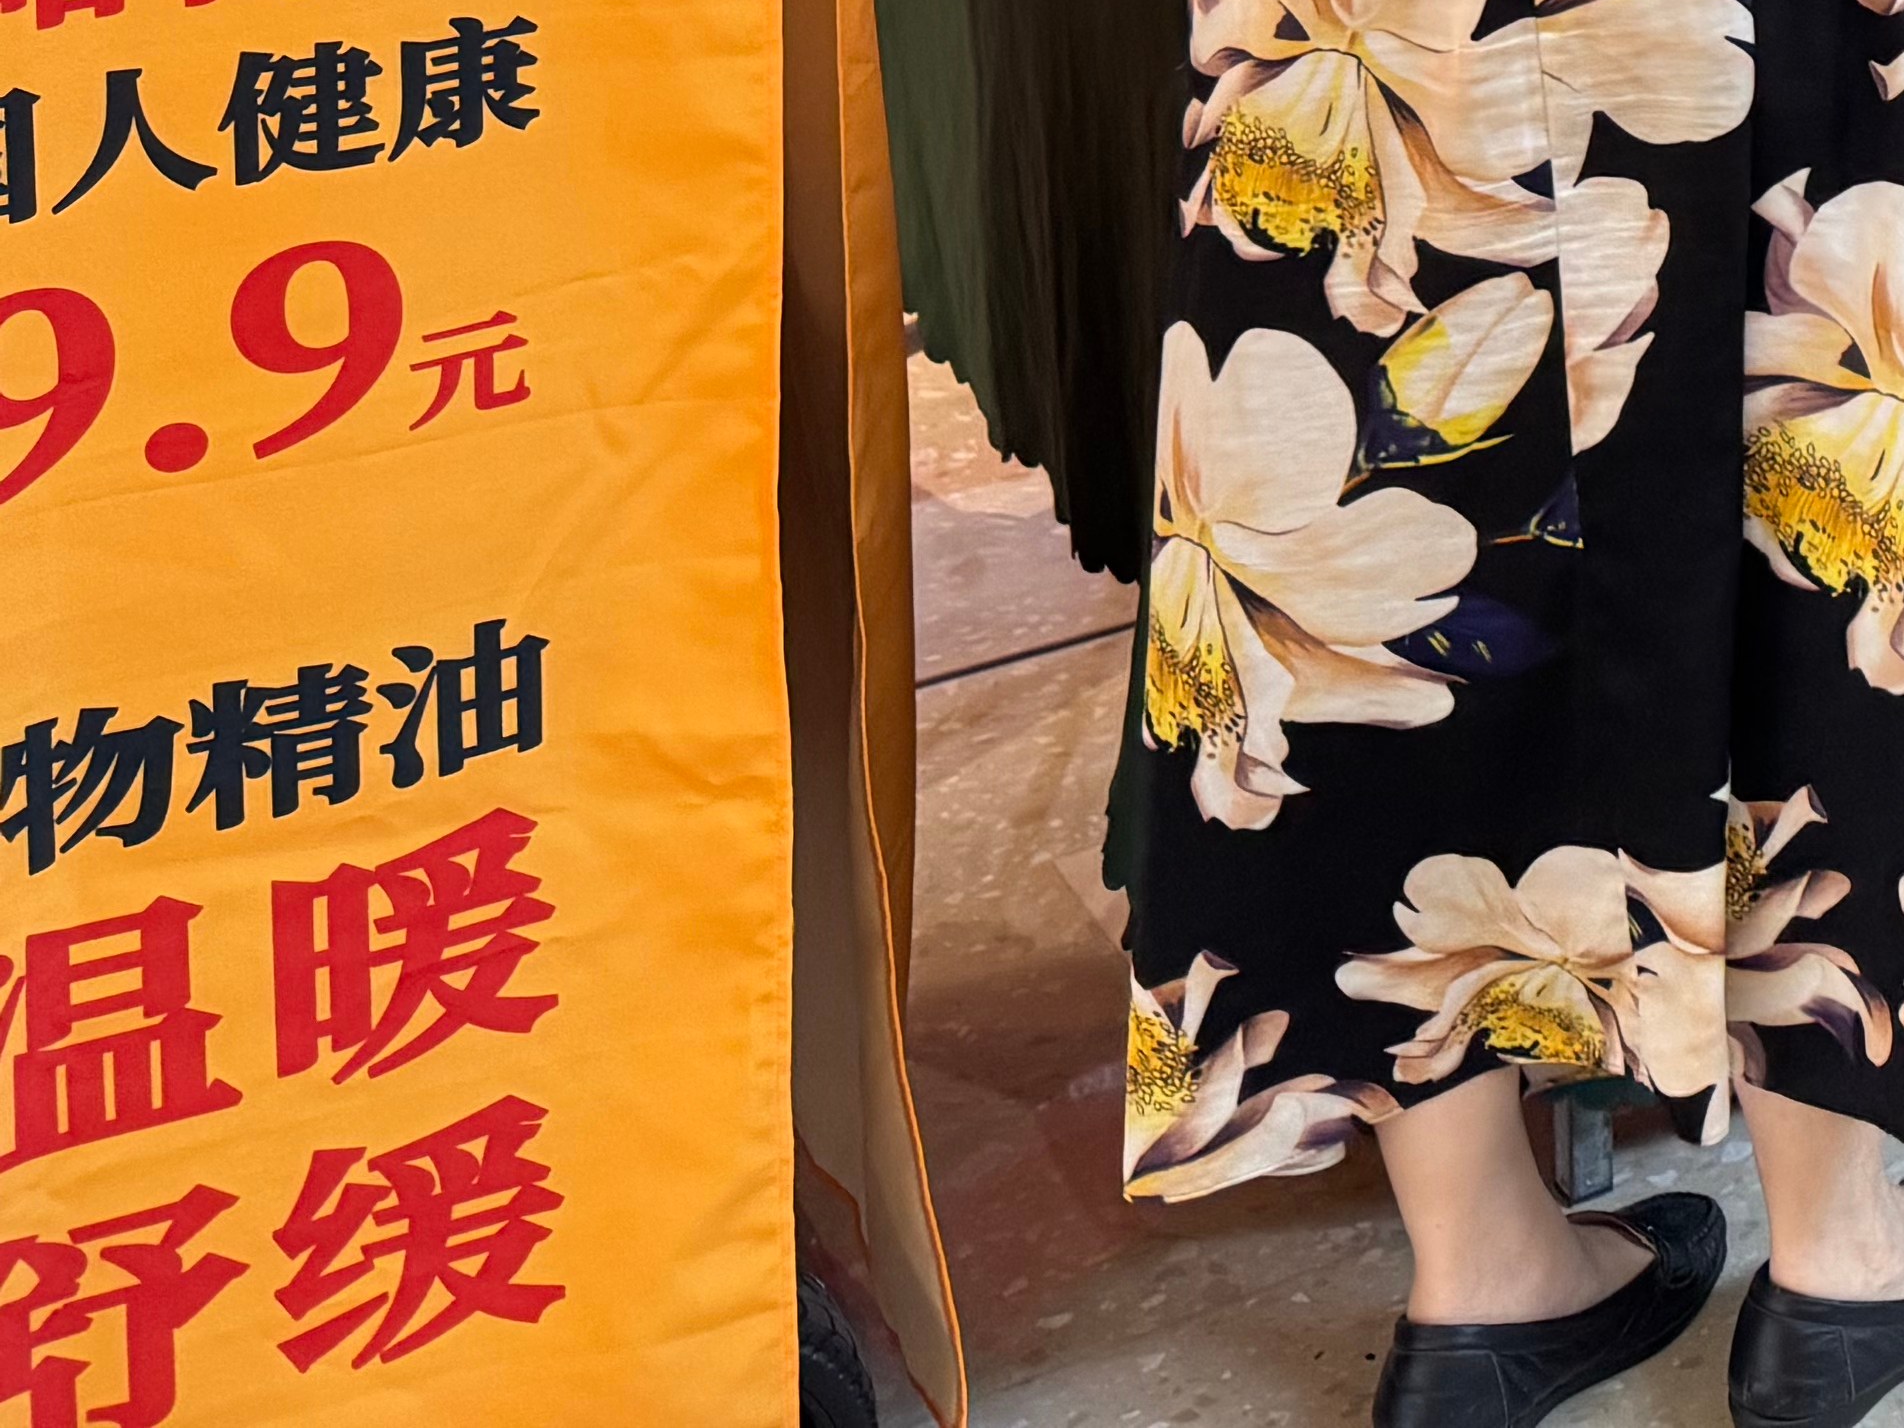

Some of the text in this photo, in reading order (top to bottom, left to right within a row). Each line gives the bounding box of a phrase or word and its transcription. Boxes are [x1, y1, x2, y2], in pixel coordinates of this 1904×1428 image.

[0, 618, 549, 876] 物精油
[0, 807, 559, 1174] 温暖
[0, 1094, 566, 1428] 舒缓
